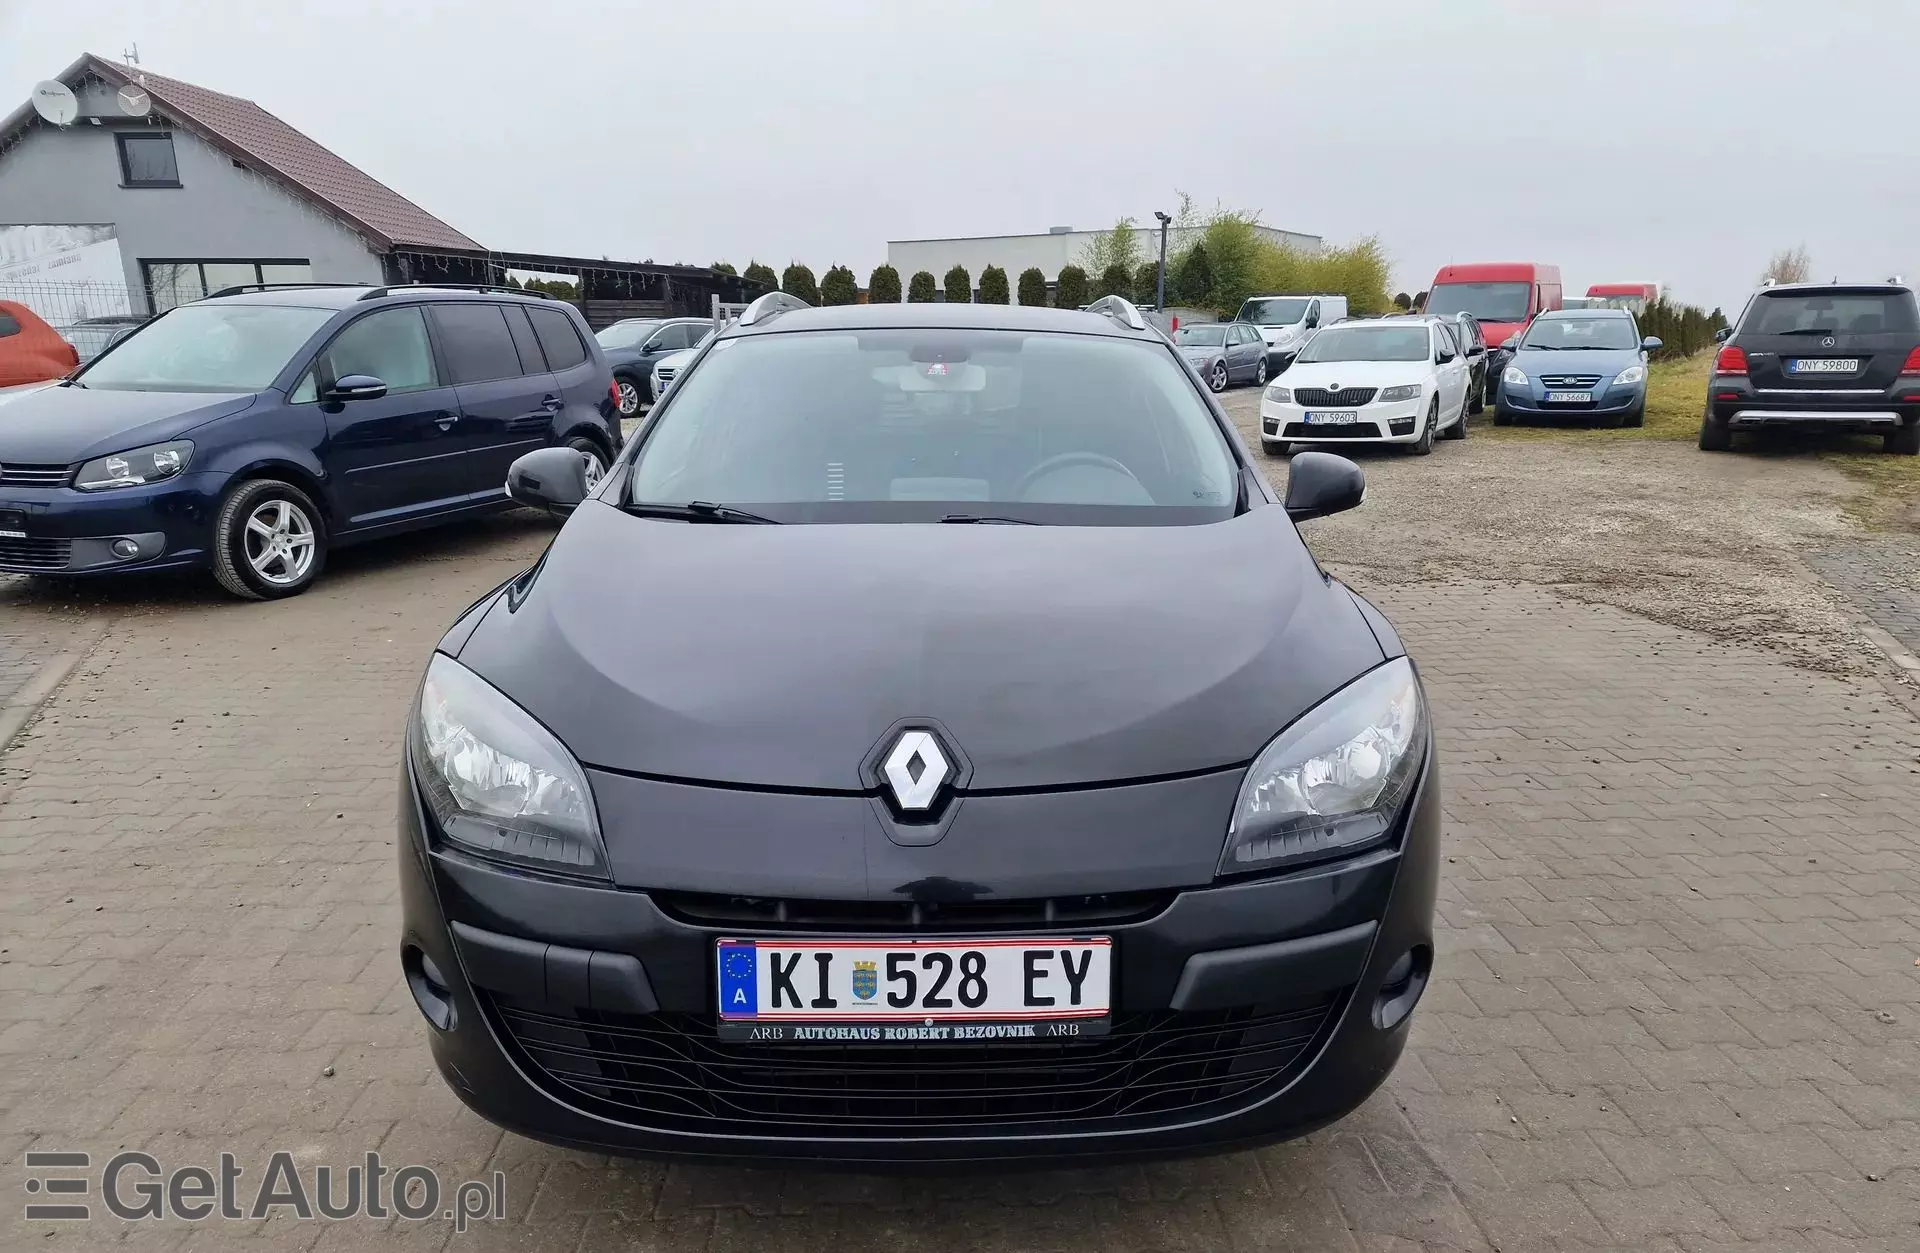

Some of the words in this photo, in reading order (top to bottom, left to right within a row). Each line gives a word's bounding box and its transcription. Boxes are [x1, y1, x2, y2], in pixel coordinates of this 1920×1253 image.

[1797, 360, 1819, 371] ONY
[1823, 360, 1857, 371] 59800
[1329, 413, 1356, 423] 59603
[770, 951, 838, 1009] KI
[886, 950, 988, 1009] 528
[1023, 949, 1092, 1007] EY
[732, 987, 748, 1005] A
[750, 1027, 783, 1040] ARB
[794, 1027, 880, 1040] AUTOHAUS
[884, 1027, 949, 1040] ROBERT
[954, 1025, 1035, 1039] BEZOVNIK
[1047, 1024, 1079, 1036] ARB
